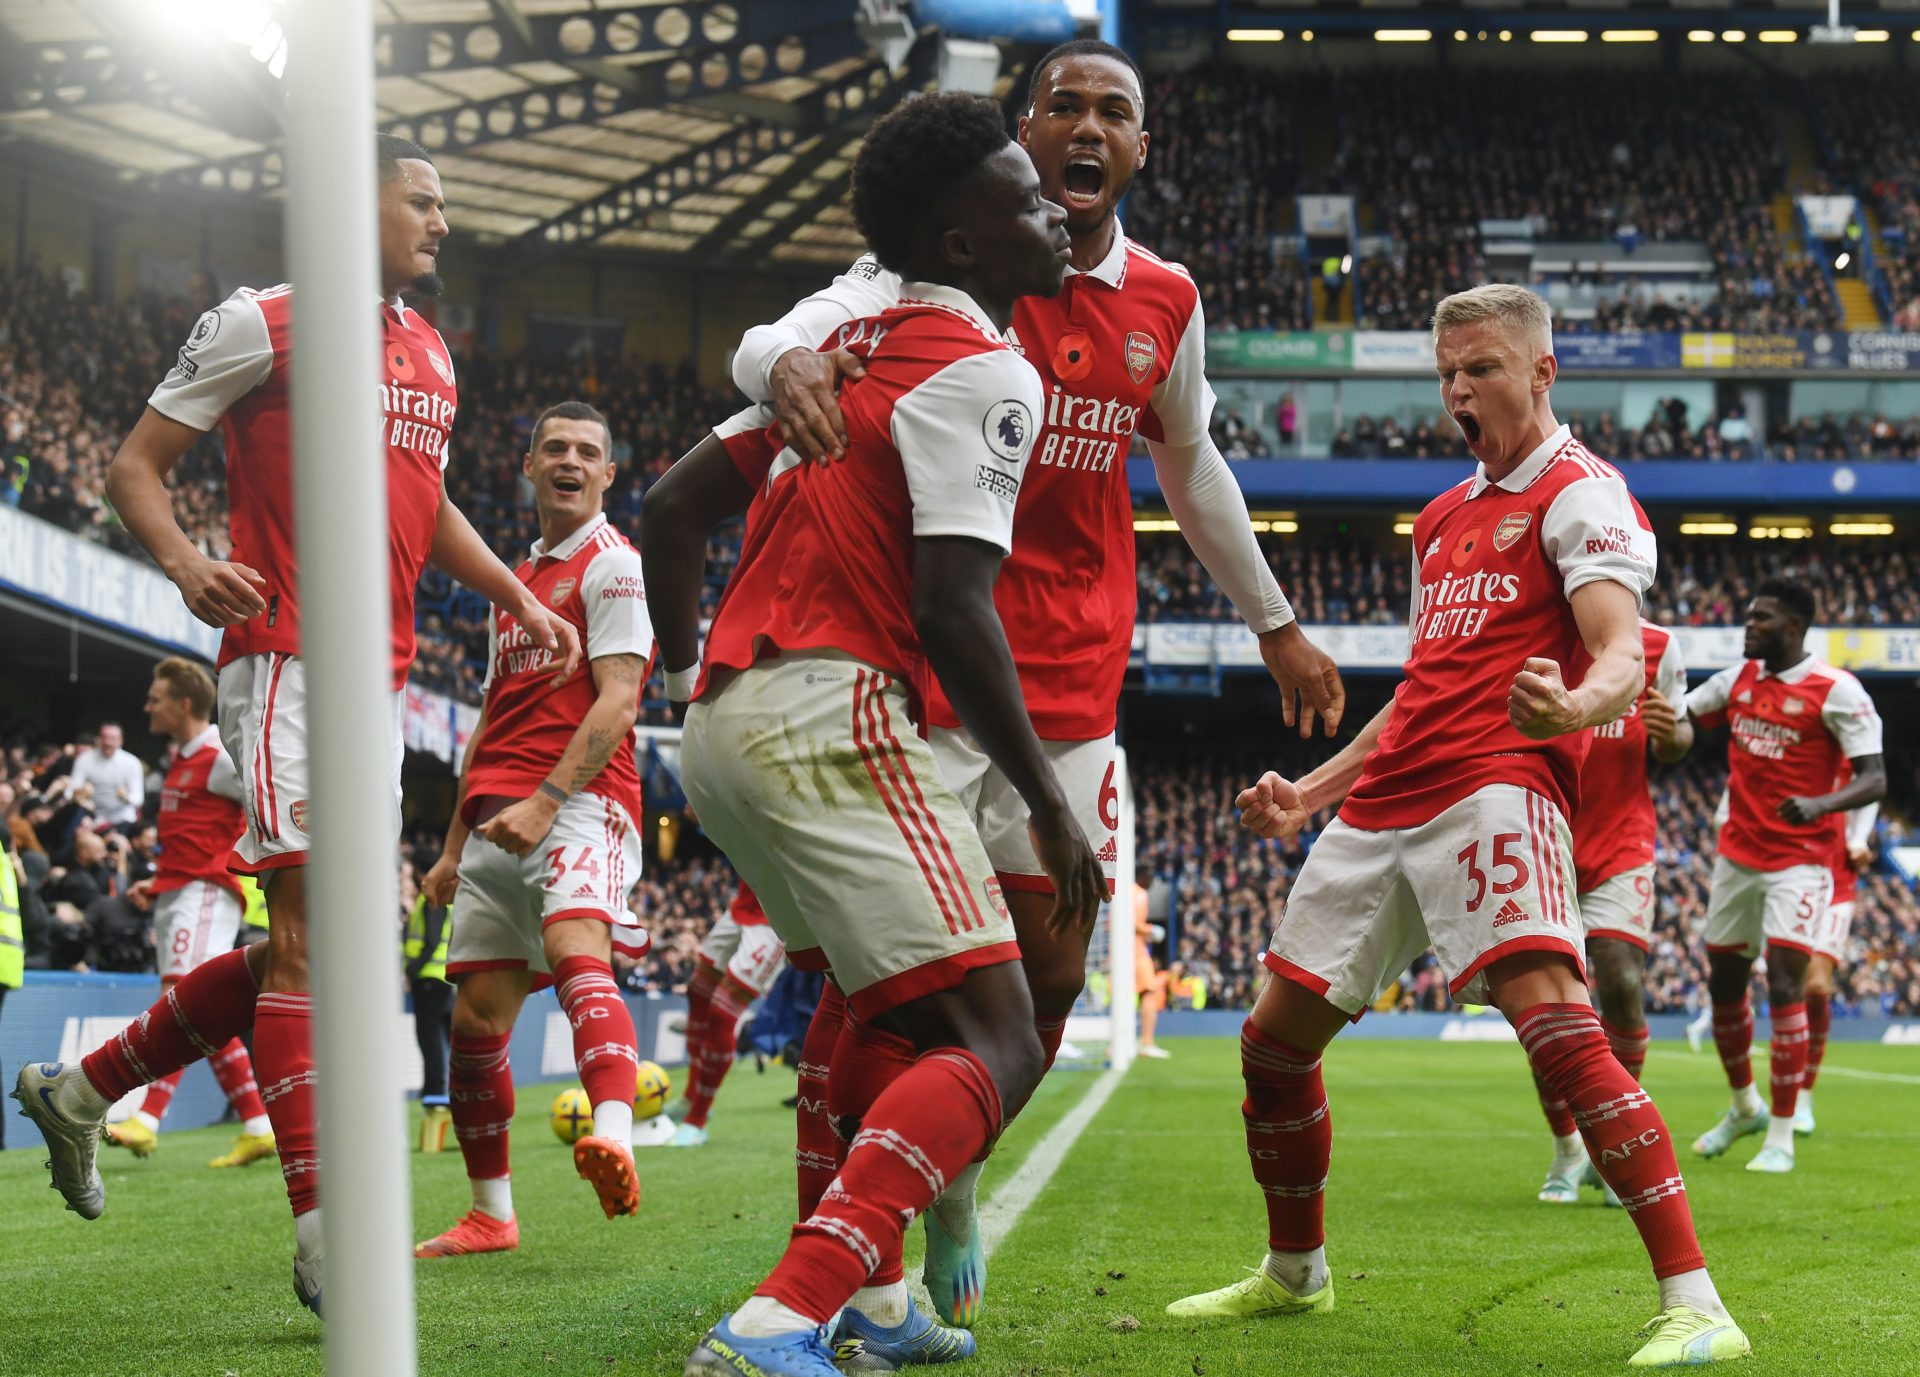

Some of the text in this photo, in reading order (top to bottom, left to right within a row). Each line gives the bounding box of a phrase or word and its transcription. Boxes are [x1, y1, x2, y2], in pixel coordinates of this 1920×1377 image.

[1848, 332, 1920, 352] CORNIS
[378, 378, 457, 432] irates
[1048, 384, 1141, 436] irates
[390, 418, 442, 457] BETTER
[1039, 433, 1118, 473] BETTER
[975, 476, 993, 490] for
[976, 465, 994, 480] No
[1602, 525, 1632, 547] VIST
[602, 588, 646, 601] RWAND
[1420, 568, 1519, 614] mirates
[1425, 608, 1489, 640] BETTER
[1593, 719, 1625, 738] TTER
[1097, 760, 1119, 831] 6
[545, 845, 600, 888] 34
[1096, 851, 1118, 863] adida
[1457, 832, 1530, 913] 35
[1634, 875, 1650, 911] 9
[1796, 891, 1813, 920] 5
[1492, 913, 1530, 928] adidas
[172, 928, 191, 955] 8
[798, 1096, 828, 1114] AF
[1601, 1128, 1660, 1166] AFC
[707, 1339, 737, 1360] new
